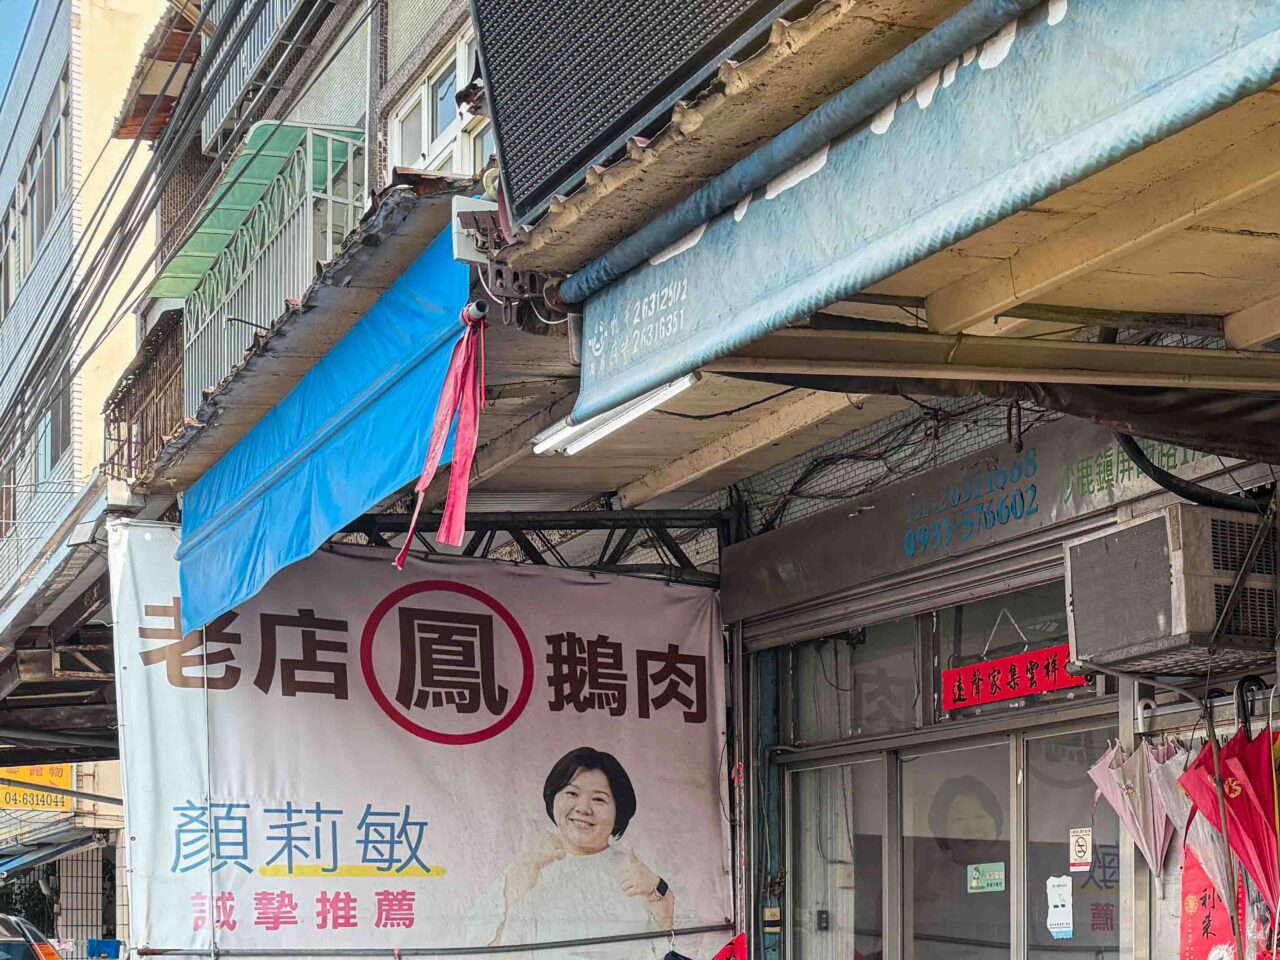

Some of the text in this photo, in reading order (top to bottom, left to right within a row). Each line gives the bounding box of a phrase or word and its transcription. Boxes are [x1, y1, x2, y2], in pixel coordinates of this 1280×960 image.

[170, 800, 431, 876] 顏莉敏
[190, 889, 417, 932] 誠摯推薦
